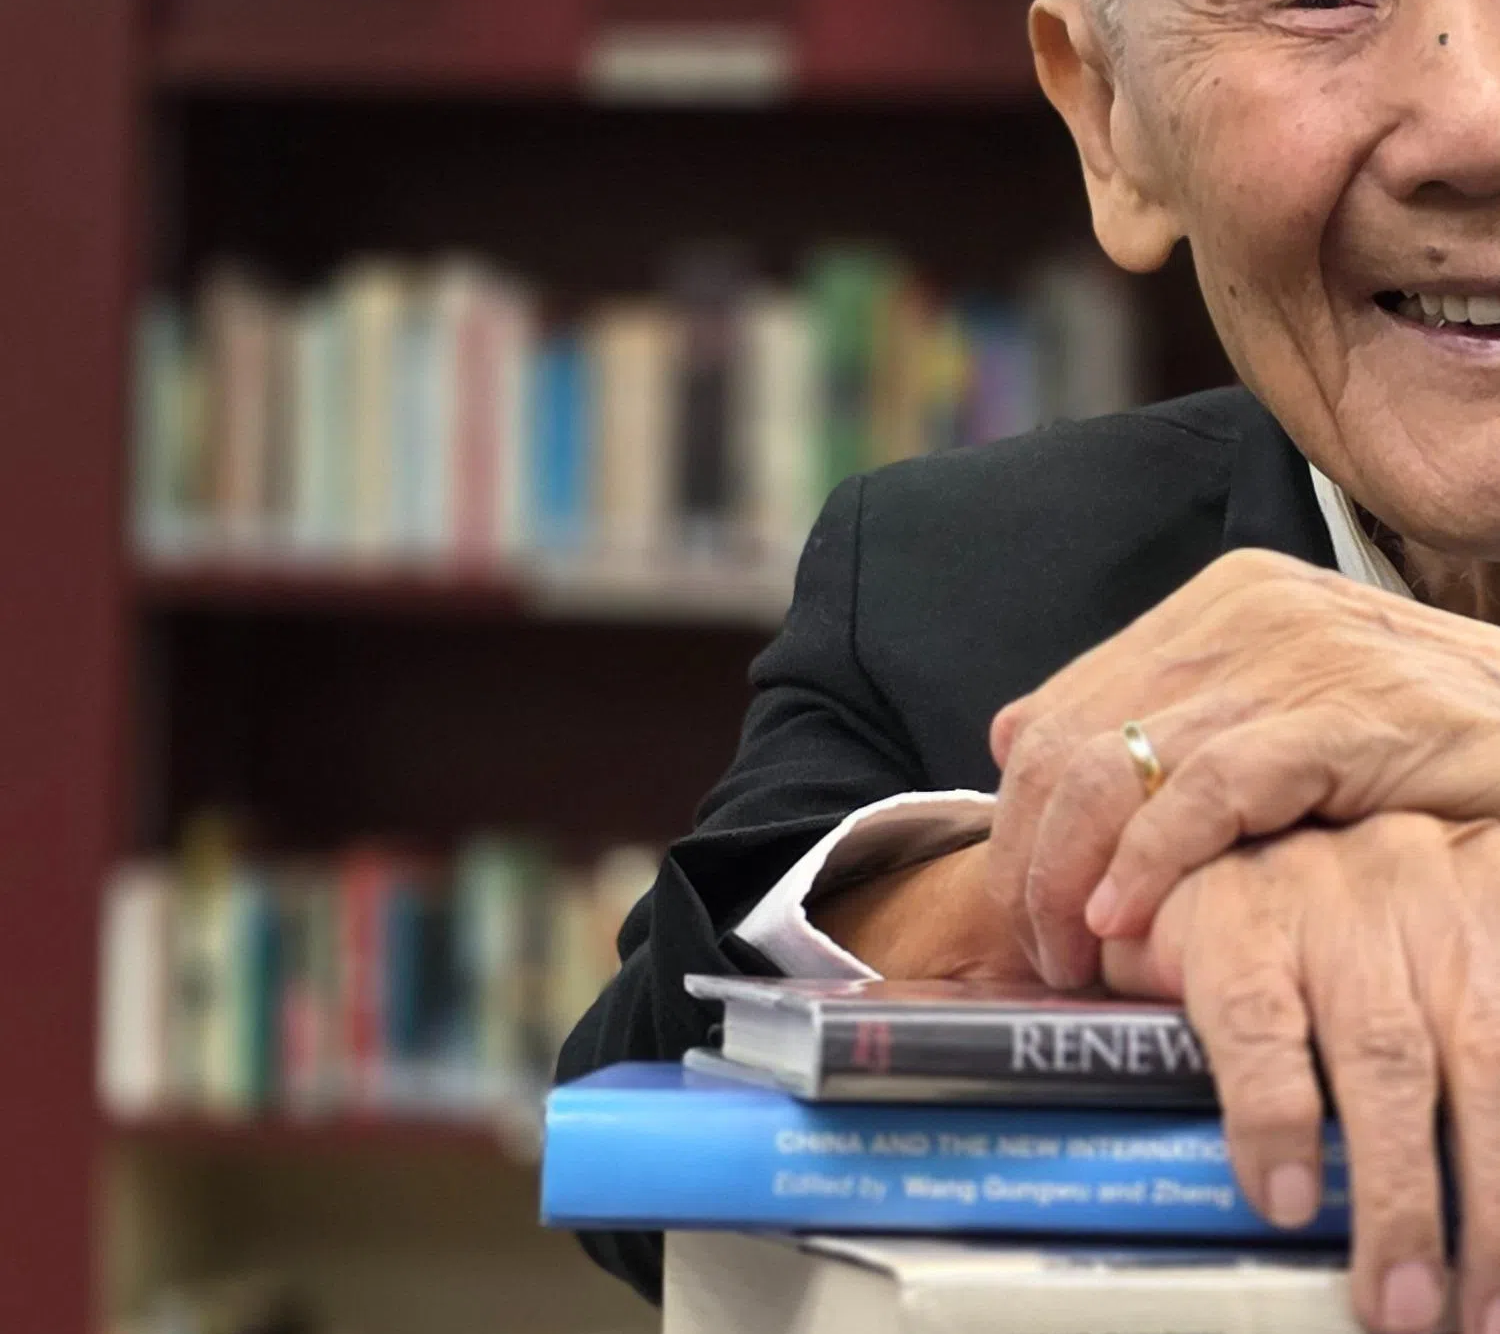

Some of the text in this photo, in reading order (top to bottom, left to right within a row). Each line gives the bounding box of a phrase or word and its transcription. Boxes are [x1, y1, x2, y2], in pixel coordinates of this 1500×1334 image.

[775, 1130, 863, 1155] CHINA
[869, 1131, 930, 1156] AND
[937, 1132, 991, 1157] THE
[996, 1133, 1060, 1159] NEW
[773, 1171, 1235, 1211] Edited by Wang Gungwu and Zheng
